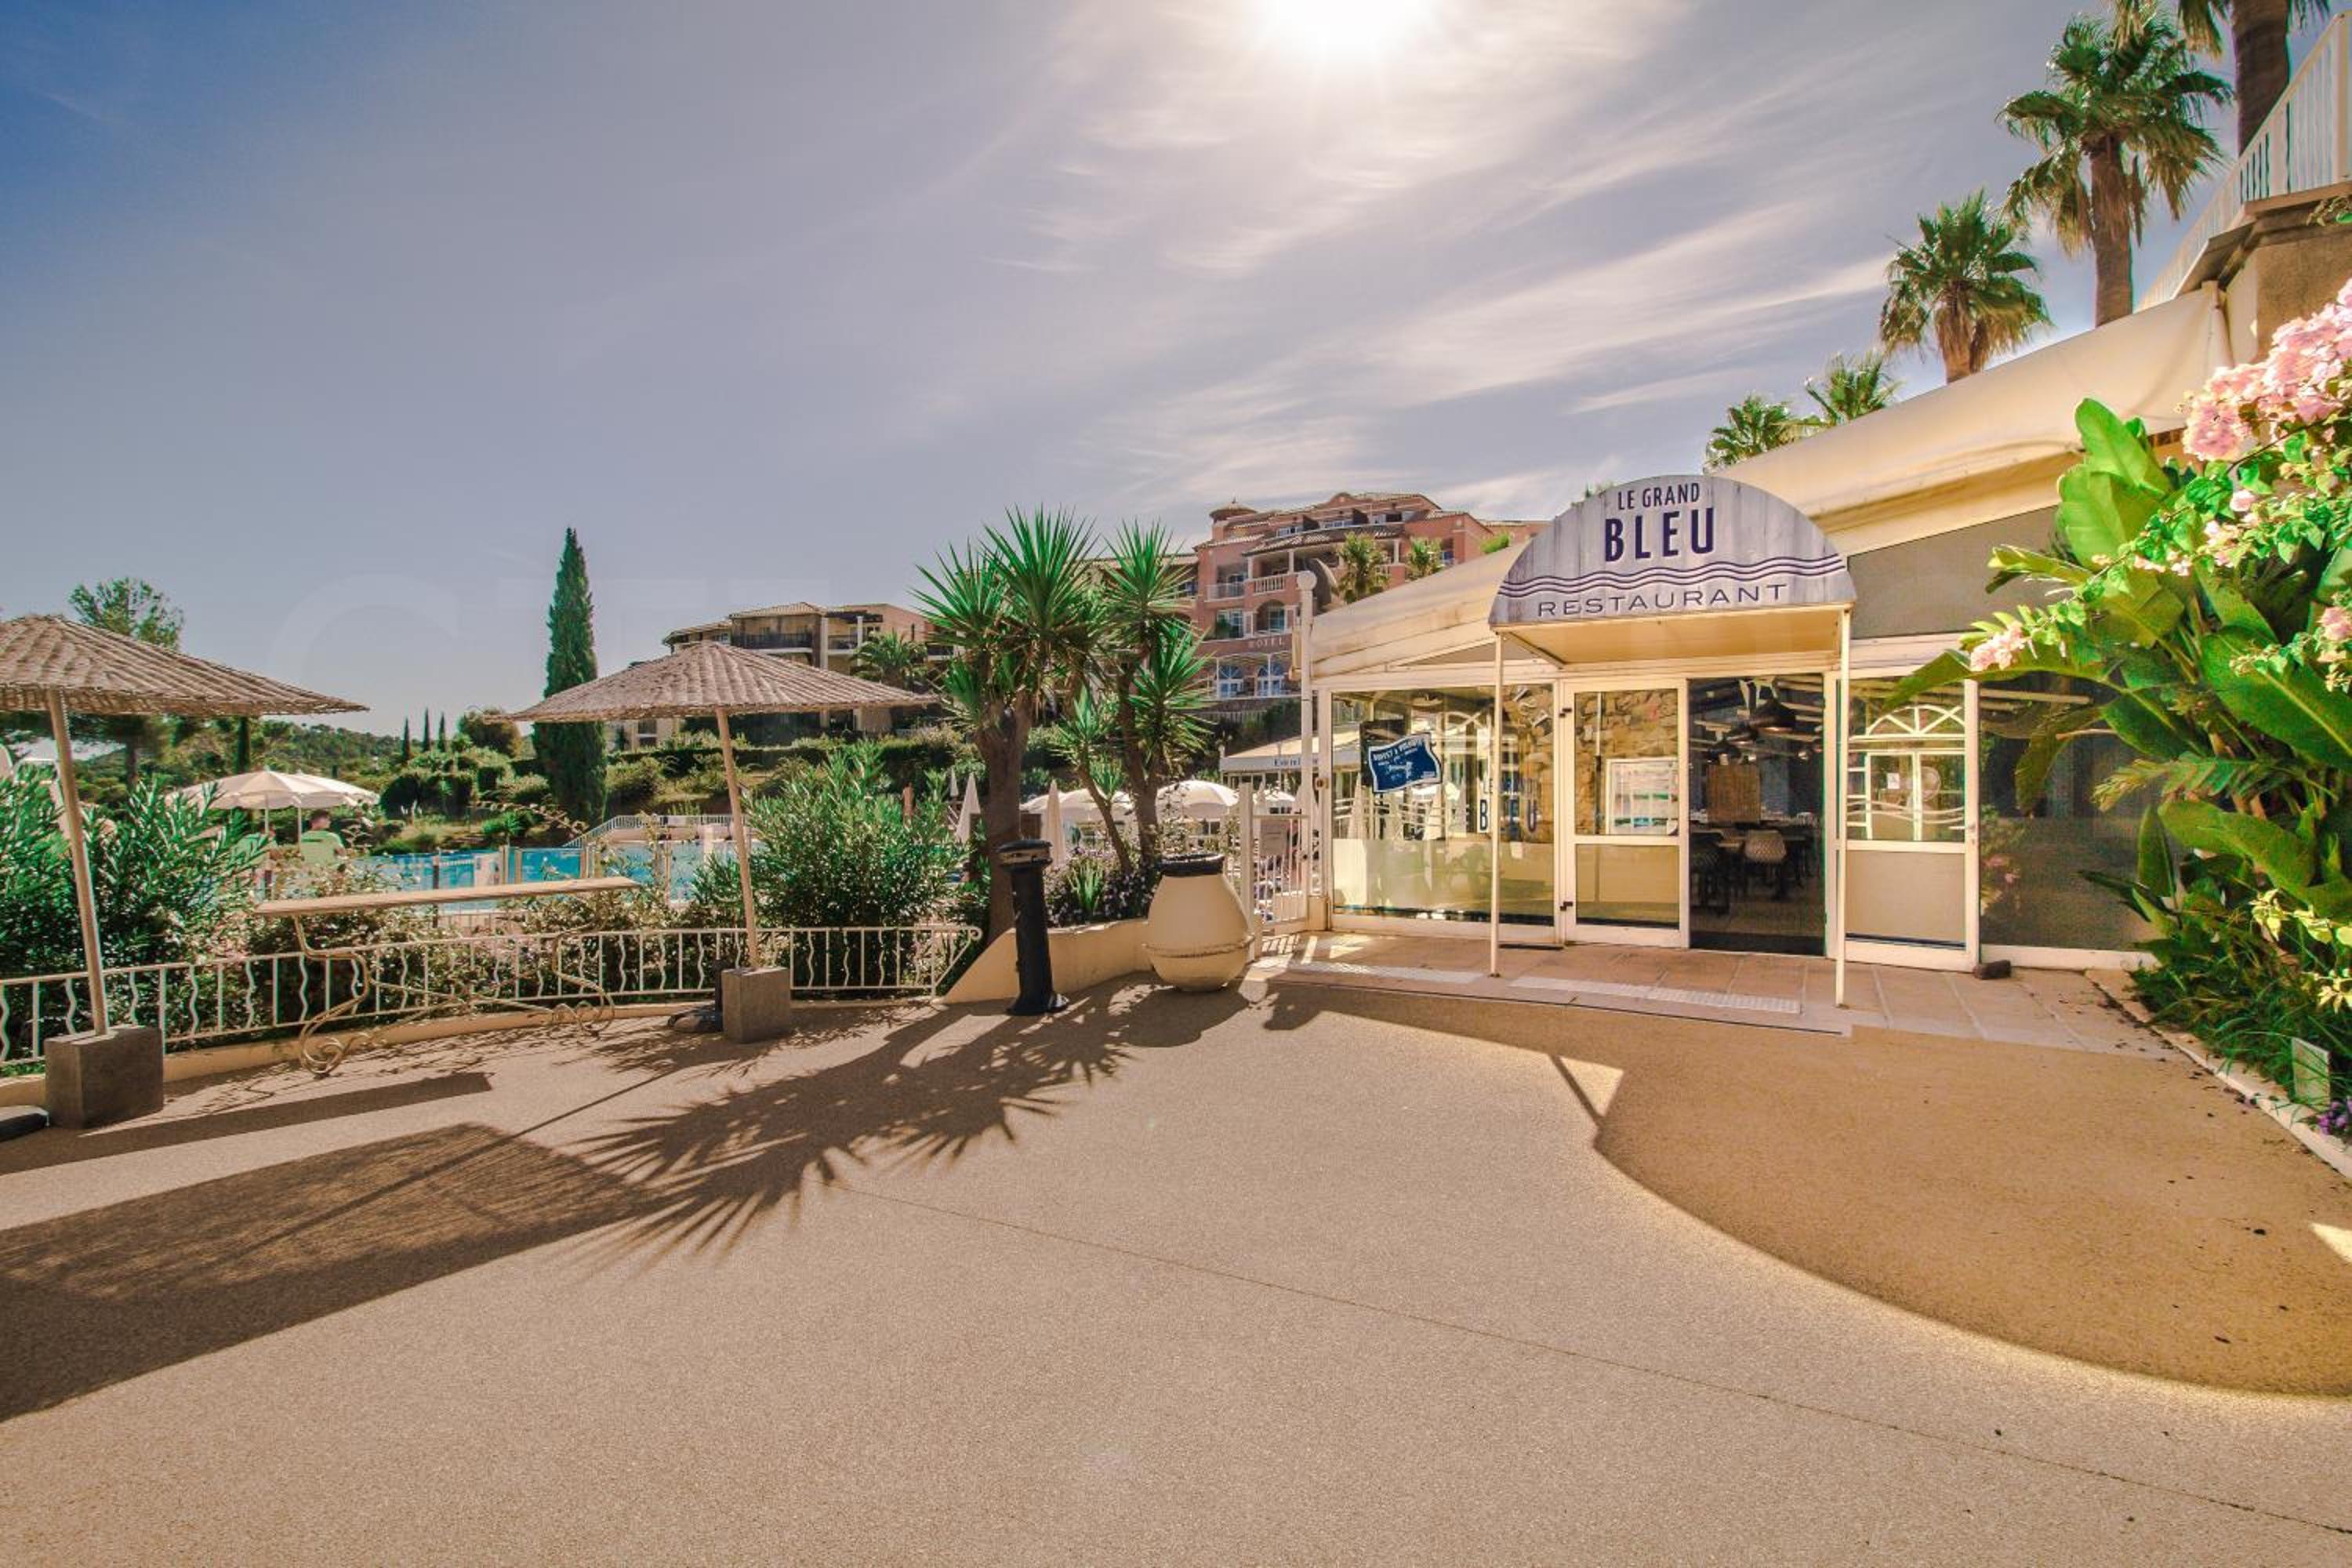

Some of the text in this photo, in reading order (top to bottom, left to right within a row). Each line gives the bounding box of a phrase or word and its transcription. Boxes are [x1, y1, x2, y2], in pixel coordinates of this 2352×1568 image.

[1617, 482, 1700, 510] LE GRAND
[1604, 506, 1714, 562] BLEU
[1537, 583, 1788, 617] RESTAURANT
[1479, 799, 1537, 833] BEU
